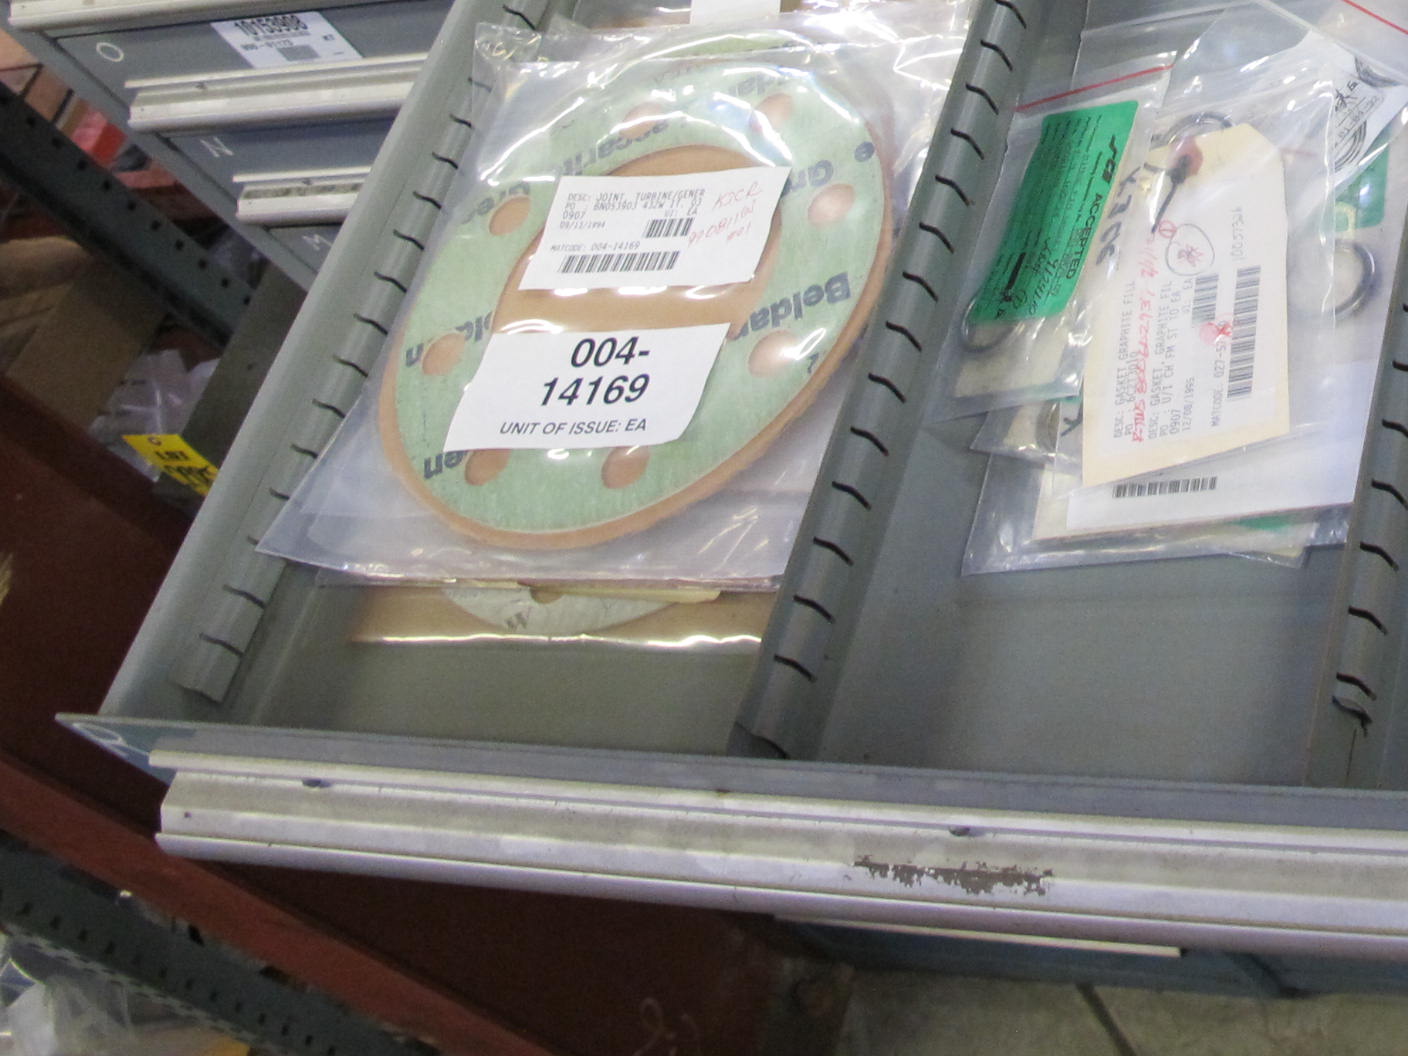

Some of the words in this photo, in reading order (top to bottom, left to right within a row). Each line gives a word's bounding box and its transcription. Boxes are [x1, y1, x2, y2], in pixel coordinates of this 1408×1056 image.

[1066, 193, 1103, 280] ACCEPTED
[570, 336, 650, 368] 004-
[541, 373, 650, 406] 14169
[499, 422, 540, 435] UNIT
[542, 422, 565, 435] OF
[568, 421, 622, 435] ISSUE:
[625, 418, 646, 432] EA
